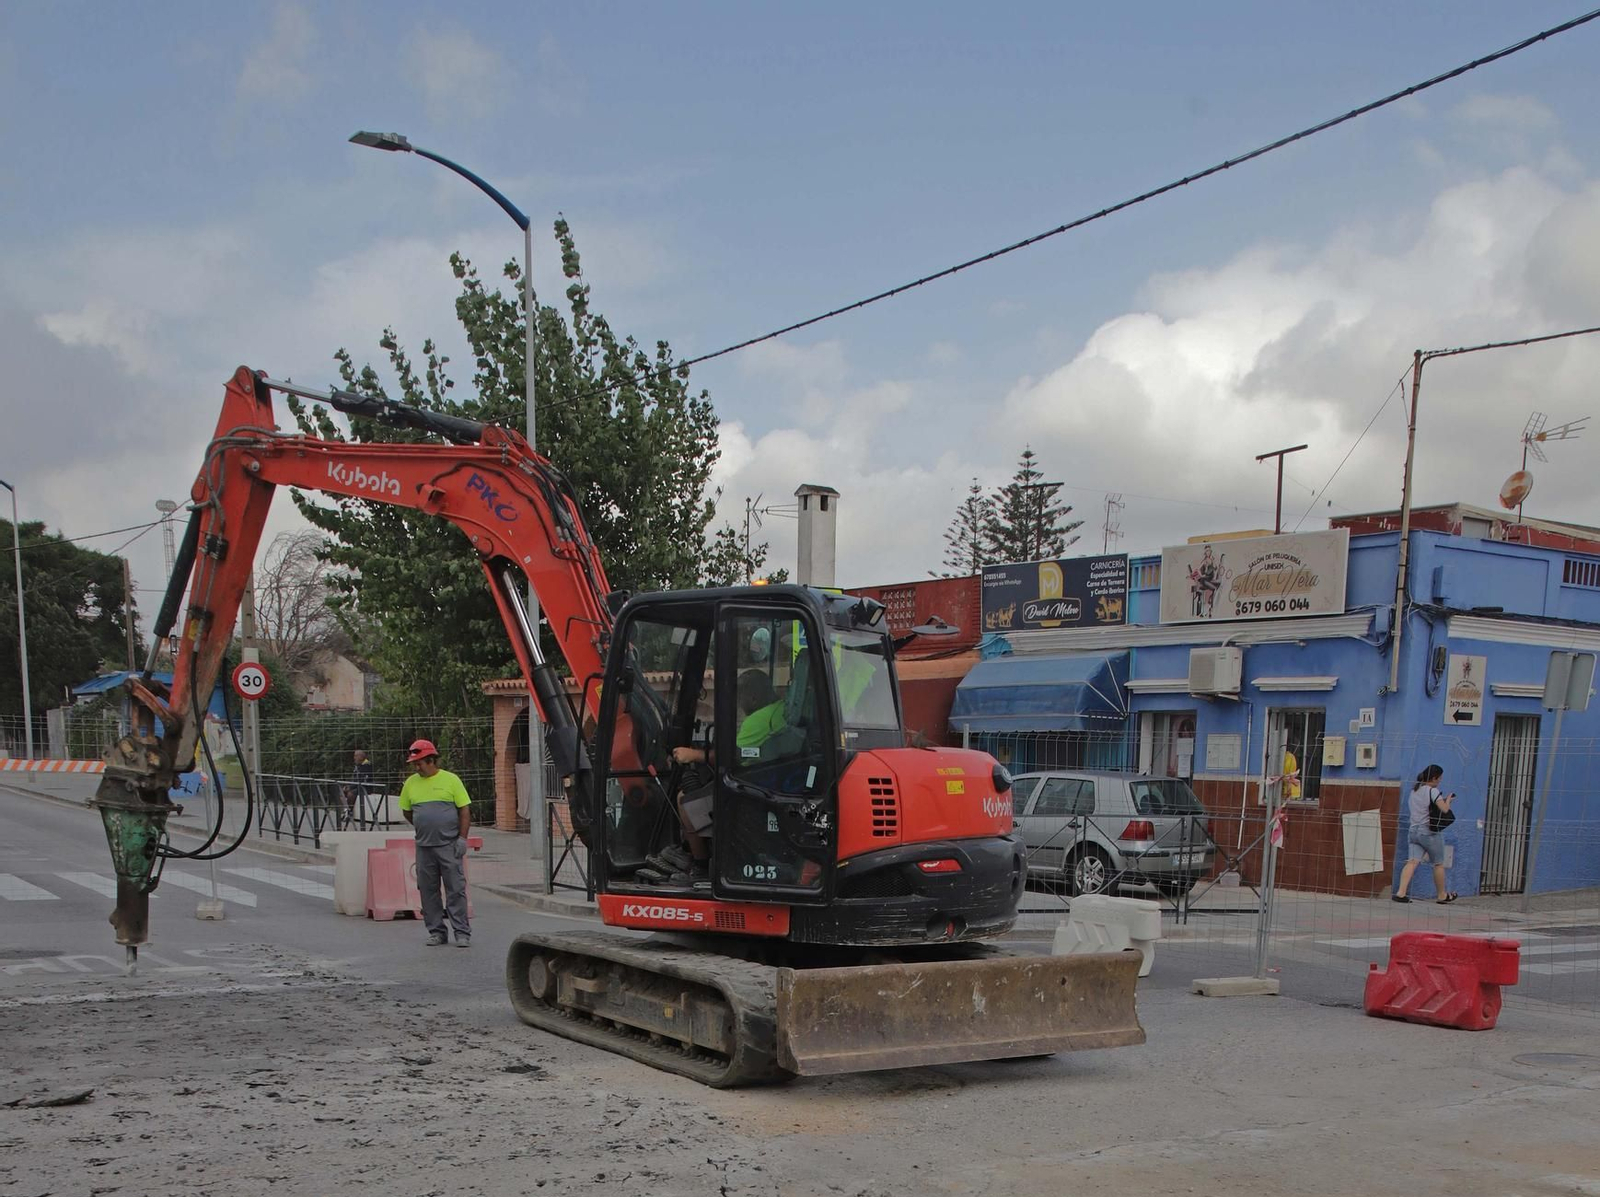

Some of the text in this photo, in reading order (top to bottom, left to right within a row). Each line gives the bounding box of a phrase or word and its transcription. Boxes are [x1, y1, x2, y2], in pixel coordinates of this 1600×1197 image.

[327, 461, 401, 496] Kubota
[466, 472, 518, 522] PKC
[1090, 560, 1125, 571] CARNICERÍA
[1091, 571, 1118, 579] Especialidad
[1277, 564, 1319, 598] Vera
[1095, 588, 1108, 596] Cerdo
[1241, 598, 1310, 614] 679 060 044
[240, 674, 263, 688] 30
